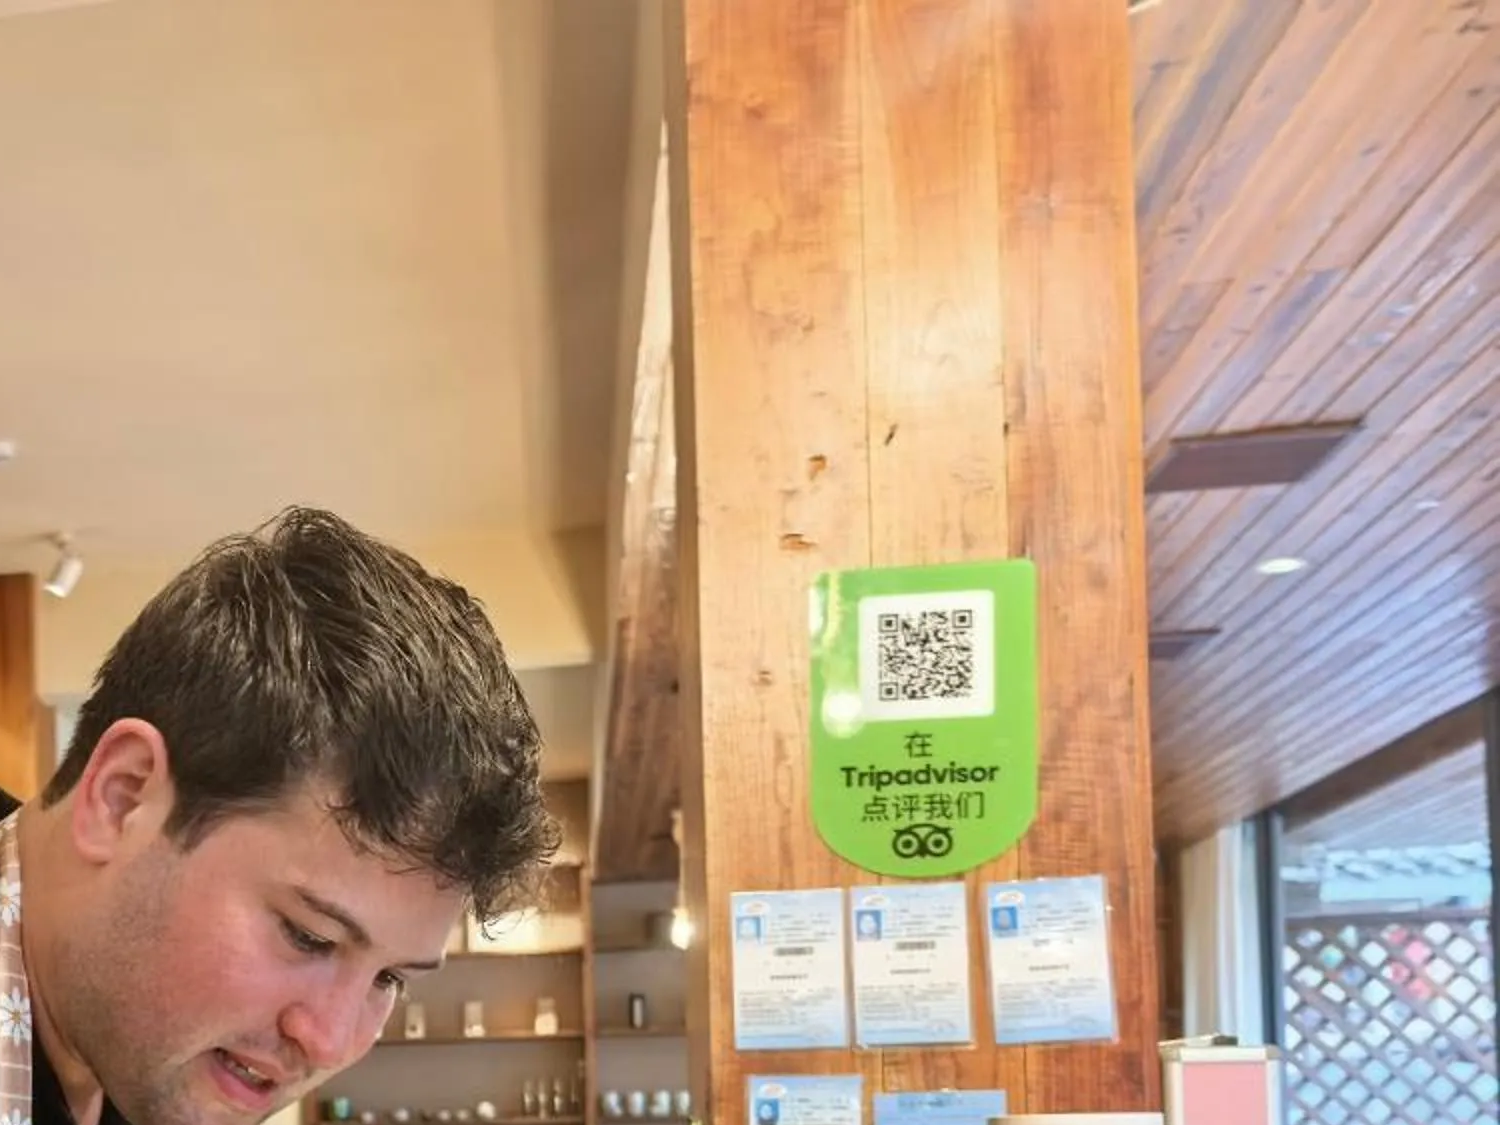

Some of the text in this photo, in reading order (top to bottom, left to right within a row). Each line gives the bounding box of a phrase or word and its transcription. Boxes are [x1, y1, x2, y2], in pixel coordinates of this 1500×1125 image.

[903, 731, 933, 759] 在
[840, 762, 1000, 792] Tripadvisor
[861, 791, 985, 822] 点评我们
